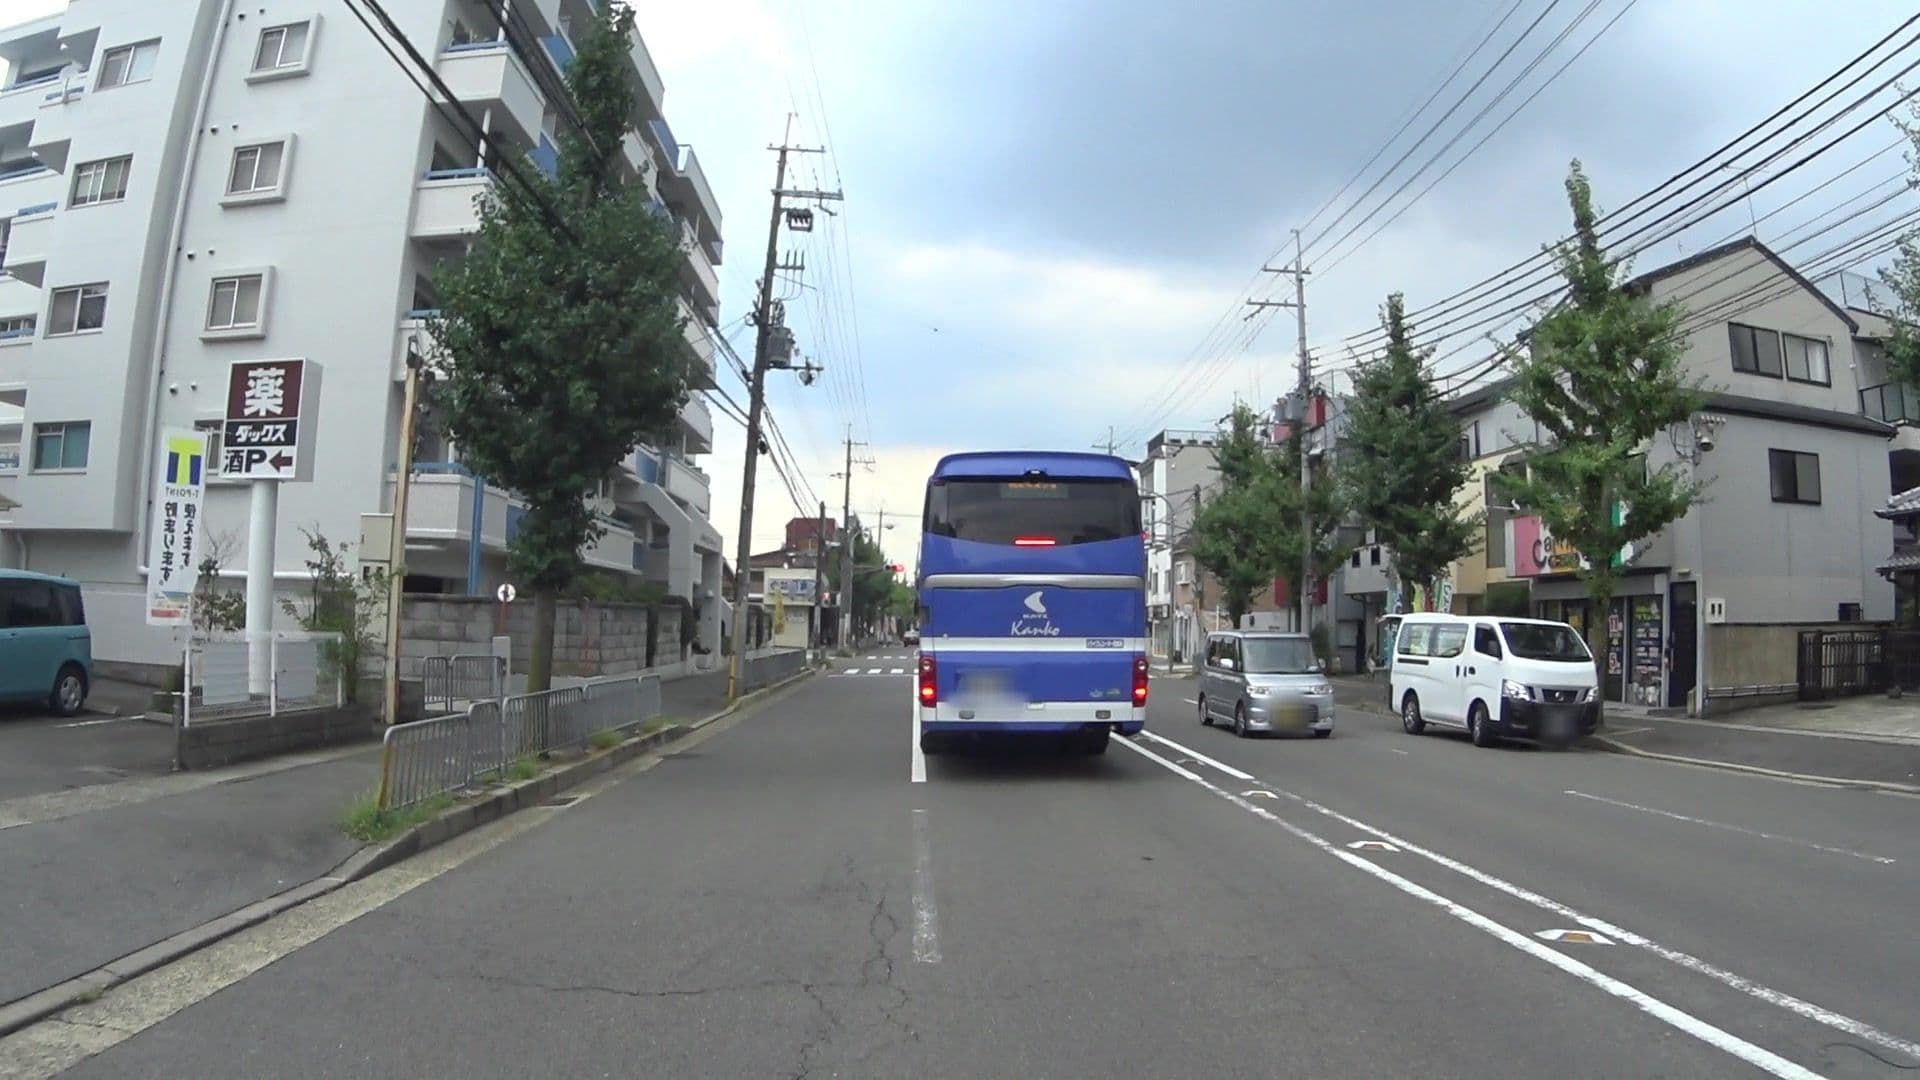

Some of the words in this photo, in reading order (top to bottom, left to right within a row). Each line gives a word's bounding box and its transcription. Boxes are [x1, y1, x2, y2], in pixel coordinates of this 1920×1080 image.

[243, 367, 286, 417] 薬
[235, 424, 286, 442] ダックス
[1011, 620, 1061, 636] Kanko
